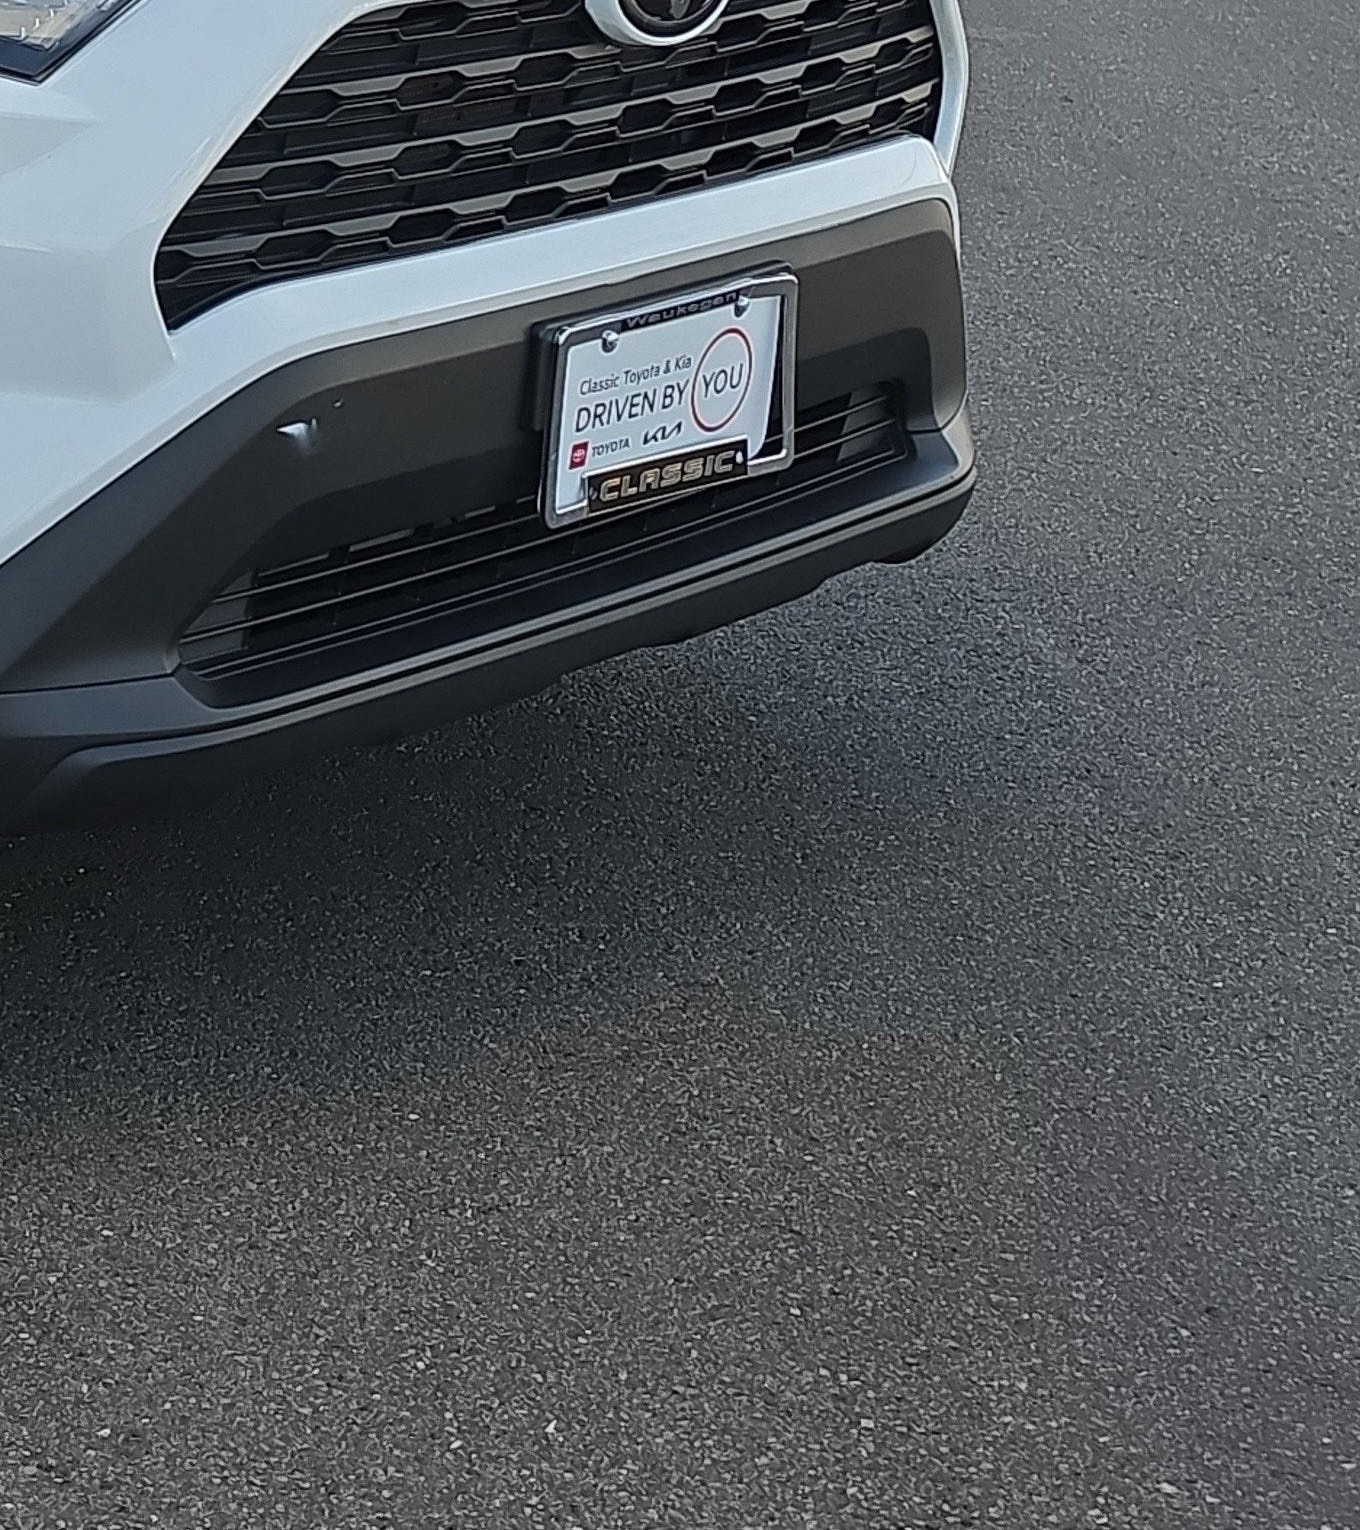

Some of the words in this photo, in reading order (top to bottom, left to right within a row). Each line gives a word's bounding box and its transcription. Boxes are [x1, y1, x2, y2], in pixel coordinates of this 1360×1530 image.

[575, 387, 657, 433] DRIVEN
[661, 379, 689, 410] BY
[701, 363, 744, 399] YOU
[580, 373, 620, 395] Classic
[624, 364, 660, 385] Toyota
[663, 359, 671, 375] &
[674, 354, 692, 372] Kia
[592, 437, 630, 457] TOYOTA
[599, 450, 735, 503] CLASSIC
